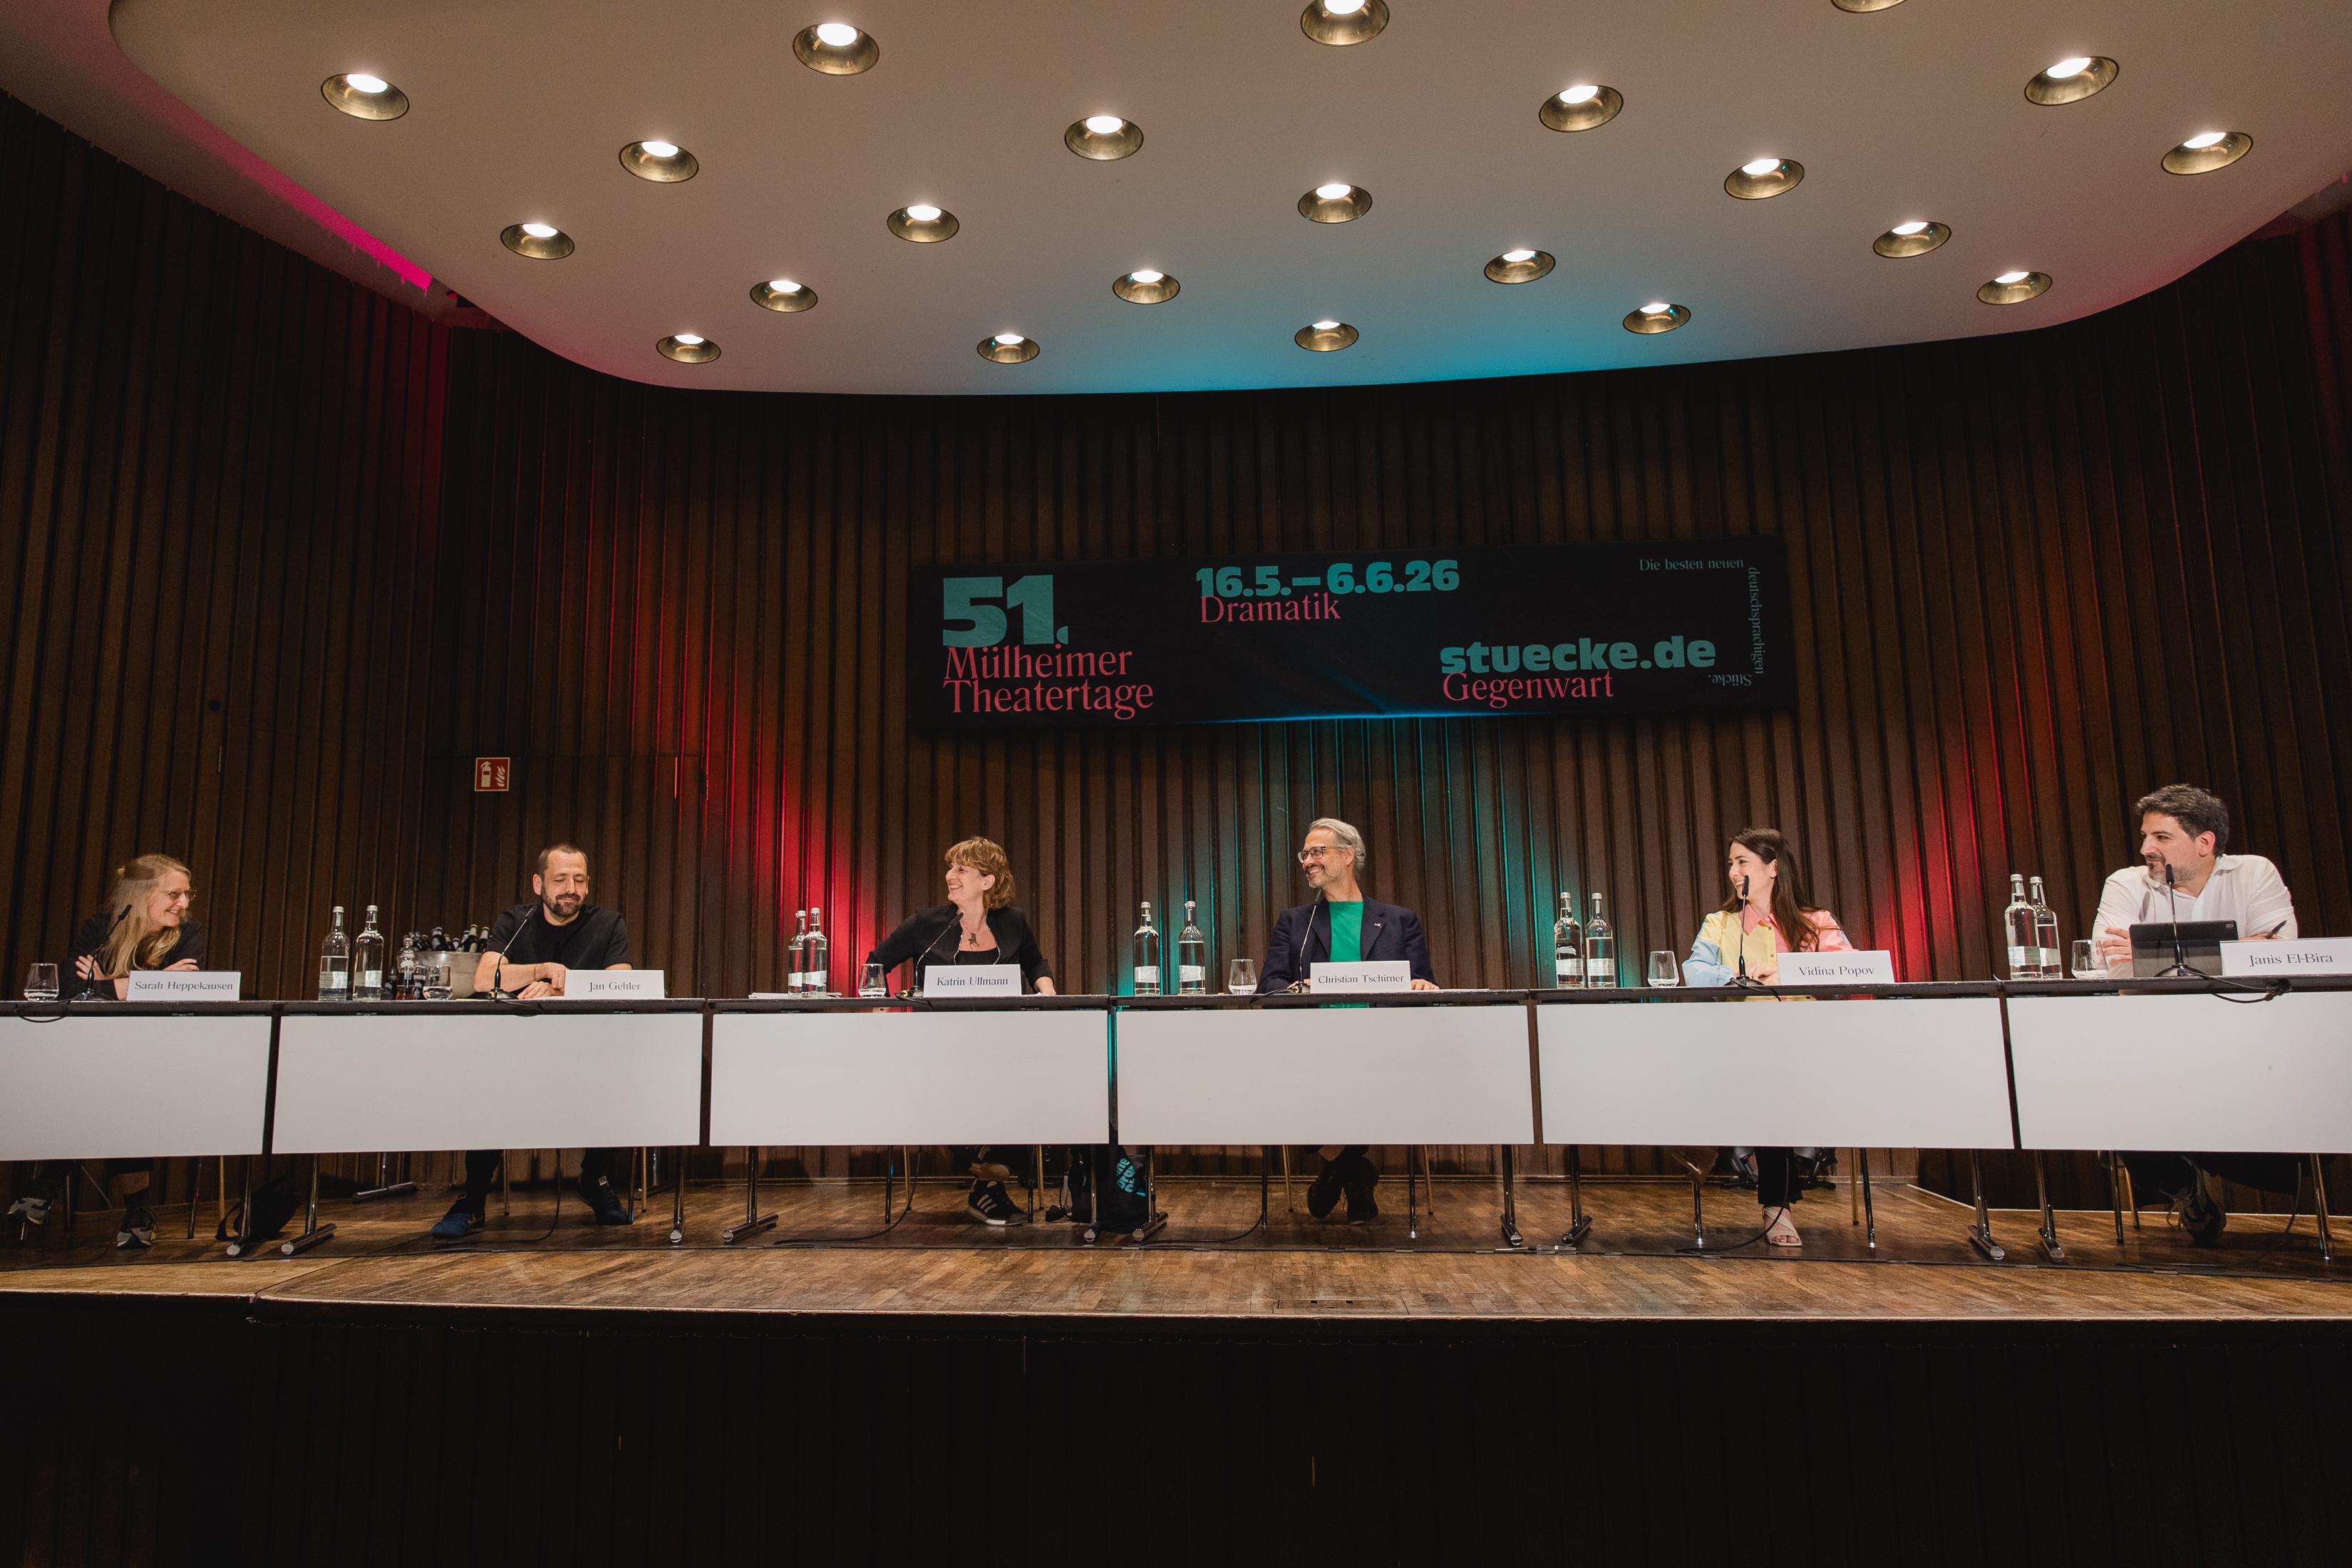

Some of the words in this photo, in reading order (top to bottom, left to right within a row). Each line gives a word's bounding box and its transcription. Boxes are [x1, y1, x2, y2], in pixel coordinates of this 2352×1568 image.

[1639, 559, 1661, 571] Die
[1665, 559, 1703, 569] besten
[1708, 559, 1744, 569] neuen
[943, 574, 1068, 648] 51.
[1200, 592, 1341, 623] Dramatik
[1748, 567, 1766, 674] deutschsprachigen
[944, 644, 1133, 679] Mülheimer
[1440, 636, 1716, 674] stuecke.de
[1708, 674, 1752, 686] Stücke.
[1443, 671, 1614, 709] Gegenwart
[943, 679, 1153, 720] Theatertage
[2249, 954, 2281, 967] Janis
[2286, 953, 2333, 964] El-Bira
[1798, 966, 1835, 976] Vidina
[1839, 966, 1874, 977] Popov
[134, 981, 163, 990] Sarah
[167, 981, 233, 991] Heppekausen
[937, 976, 965, 986] Katrin
[969, 976, 1009, 986] Ullmann
[1318, 975, 1358, 984] Christian
[1361, 974, 1405, 983] Tschirner
[589, 981, 604, 992] Jan
[609, 981, 641, 991] Gehler
